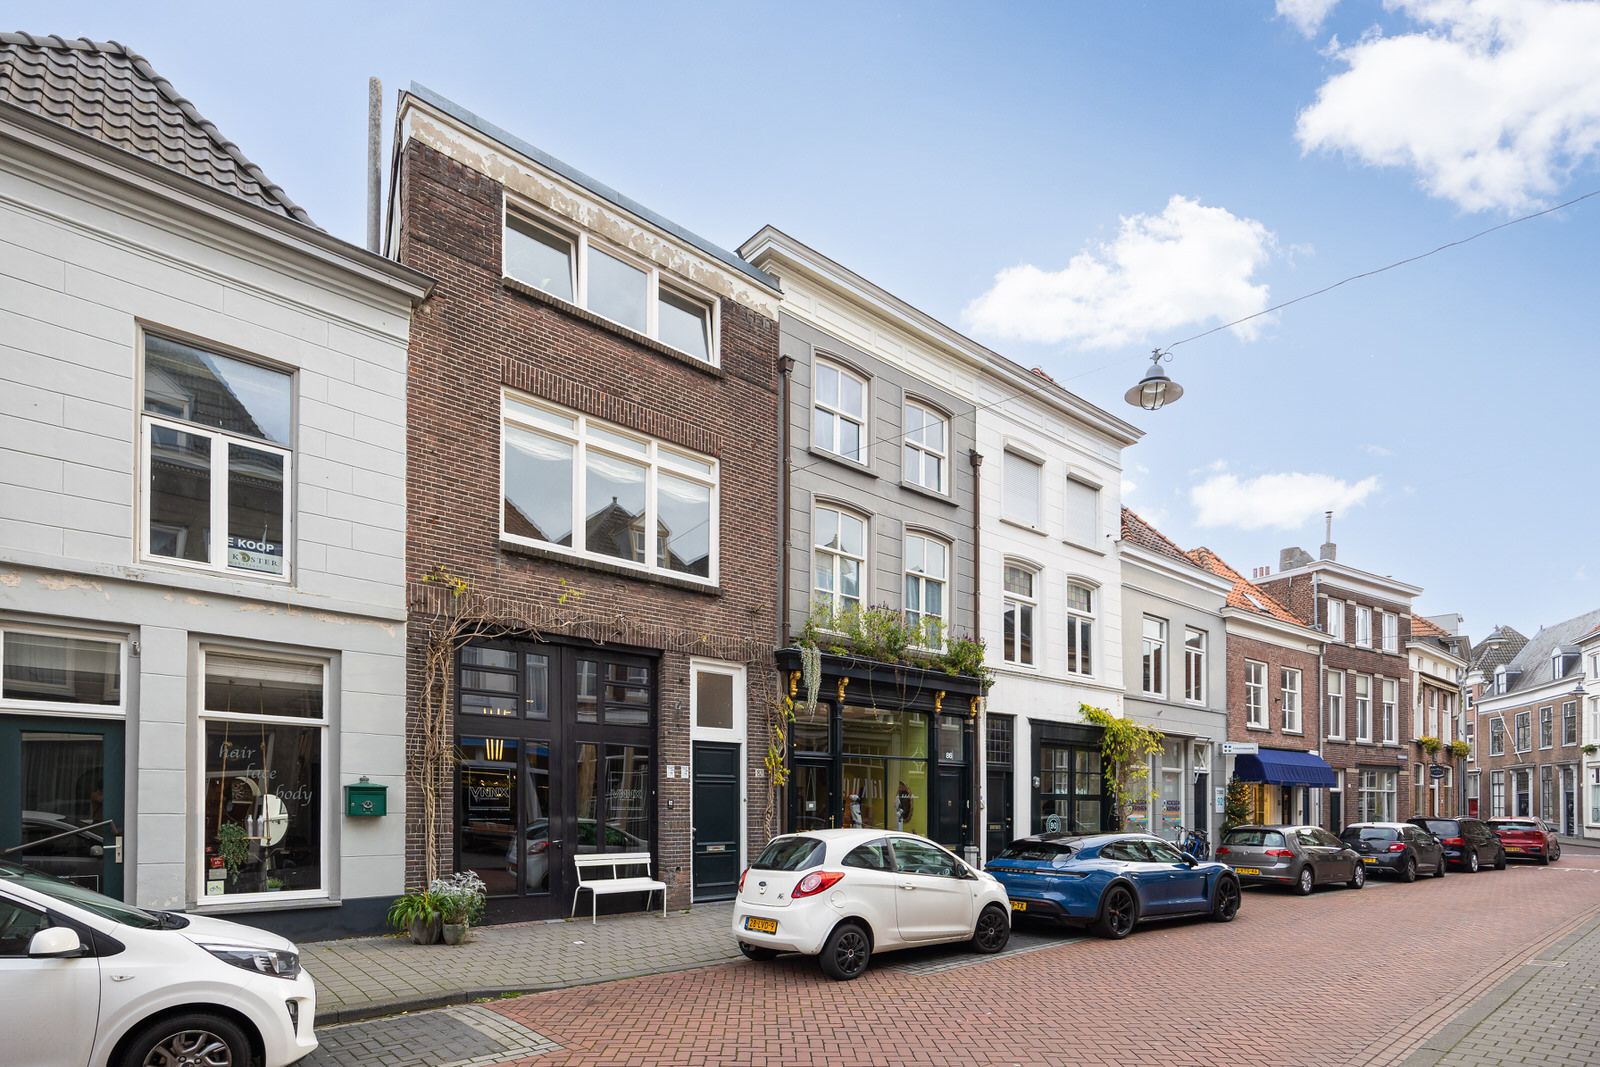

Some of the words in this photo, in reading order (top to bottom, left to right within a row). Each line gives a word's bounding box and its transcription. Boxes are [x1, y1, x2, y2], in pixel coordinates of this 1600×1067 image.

[238, 538, 275, 552] KOOP
[219, 741, 256, 759] hair
[945, 751, 953, 759] 86
[275, 784, 313, 807] body
